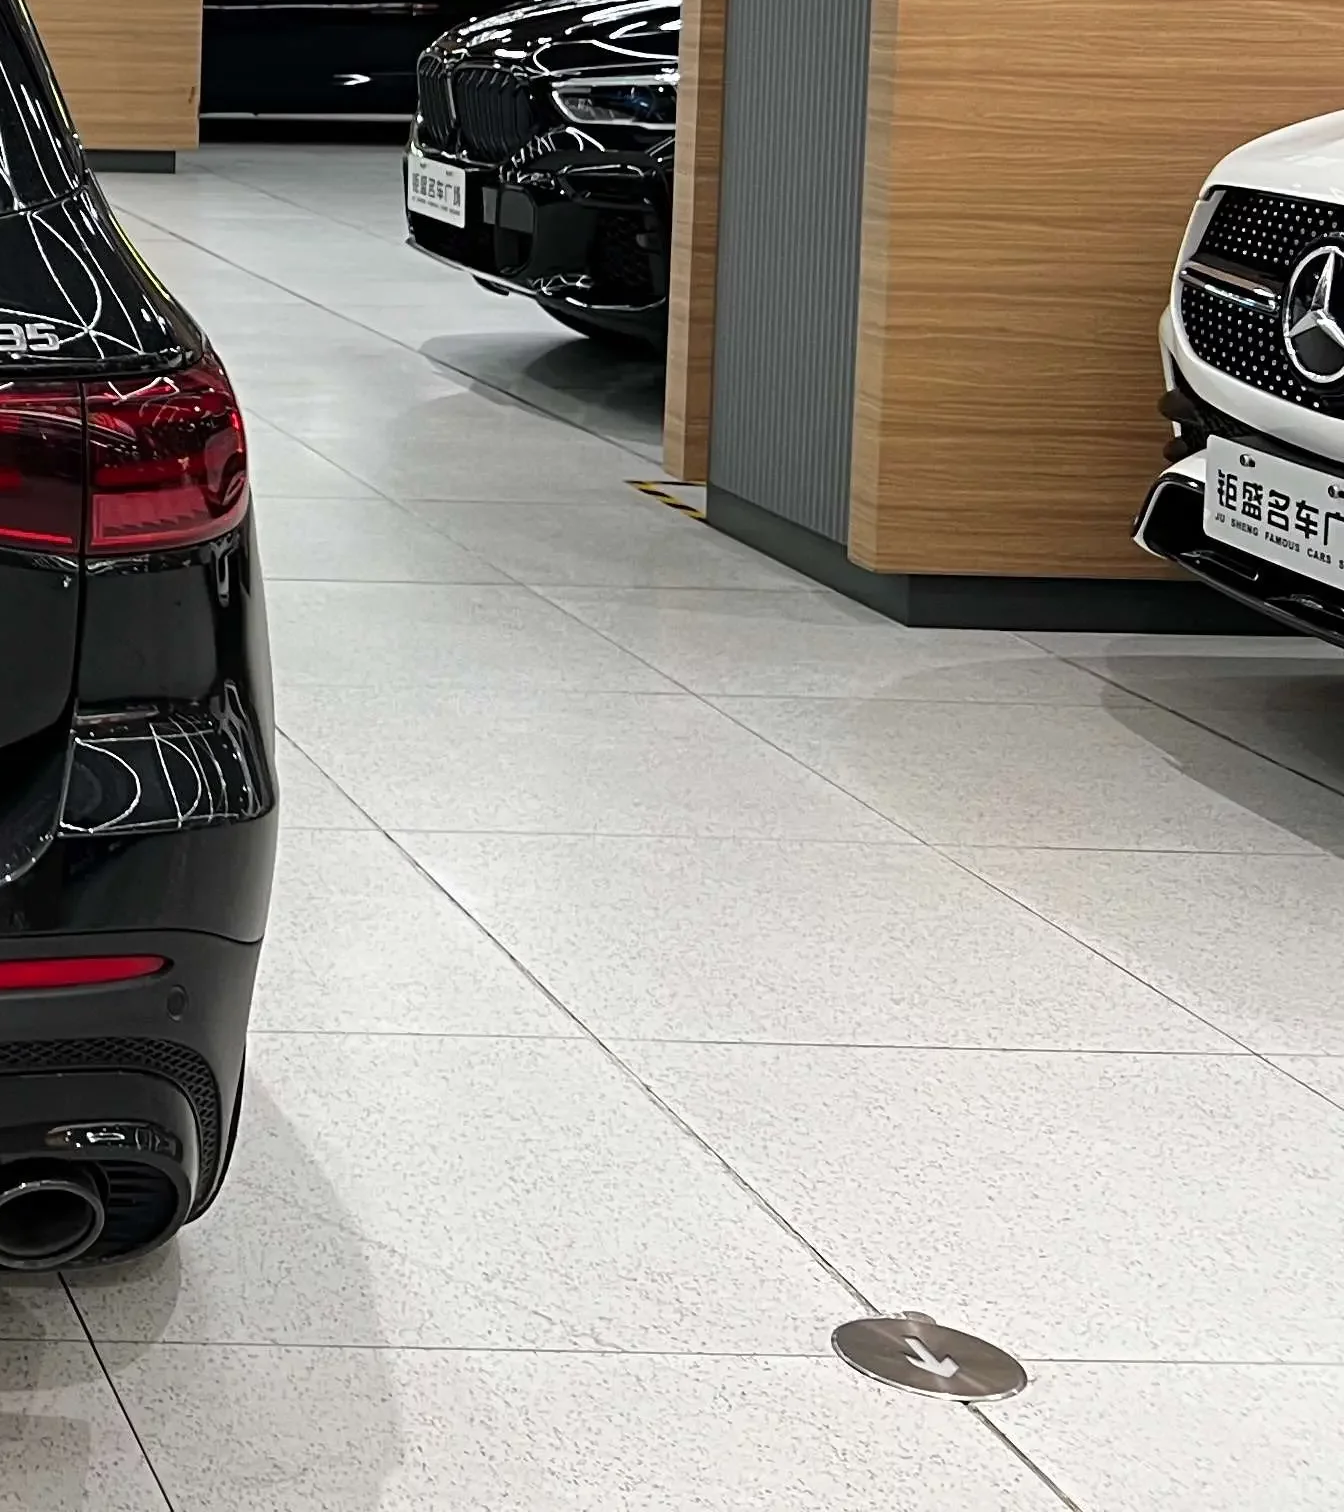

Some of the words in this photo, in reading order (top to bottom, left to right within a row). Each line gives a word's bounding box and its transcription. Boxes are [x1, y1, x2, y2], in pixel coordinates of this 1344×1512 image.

[1231, 519, 1259, 537] SHENG
[1265, 531, 1300, 553] FAMOUS
[1307, 548, 1332, 565] CARS
